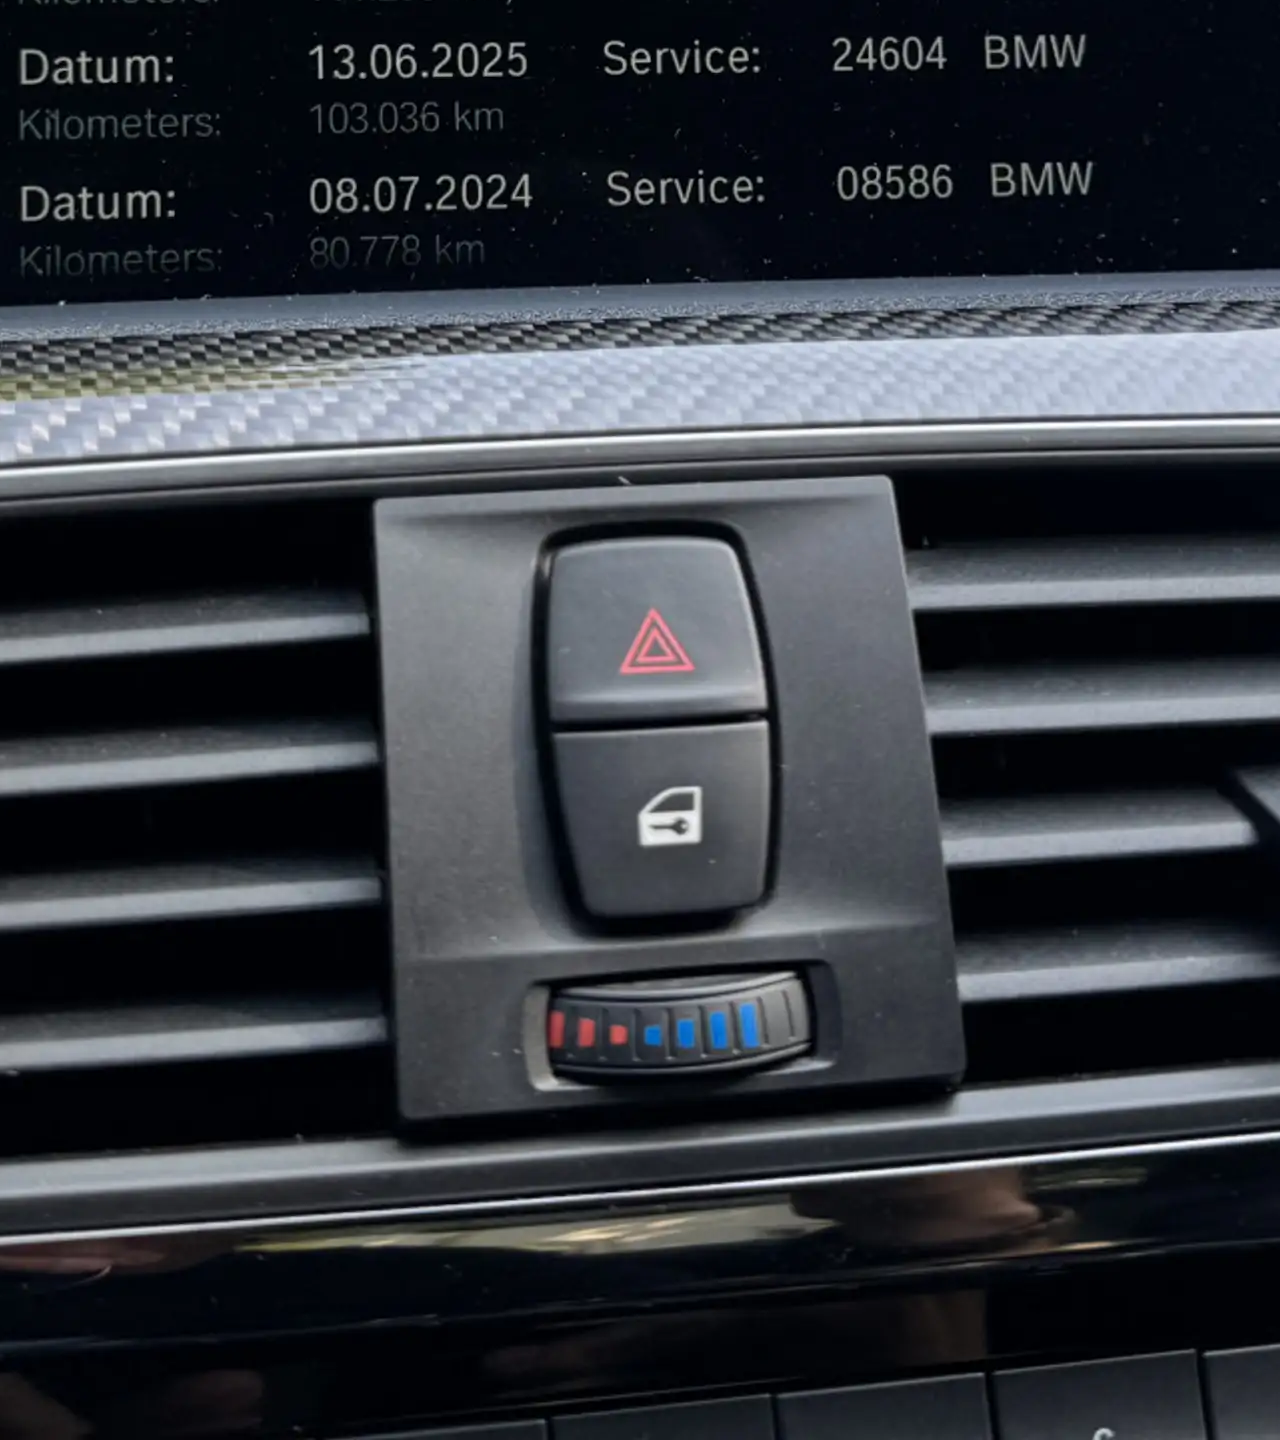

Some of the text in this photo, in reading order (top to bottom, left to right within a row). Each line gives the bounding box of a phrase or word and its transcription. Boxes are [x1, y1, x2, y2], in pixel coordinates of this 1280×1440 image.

[19, 48, 174, 86] Datum:
[308, 41, 528, 80] 13.06.2025
[603, 39, 761, 76] Service:
[832, 35, 947, 72] 24604
[984, 33, 1086, 70] BMW
[19, 100, 504, 141] Kilometers: 103.036 km
[20, 185, 176, 222] Datum:
[309, 173, 533, 214] 08.07.2024
[606, 169, 765, 207] Service:
[836, 163, 953, 201] 08586
[990, 163, 1094, 198] BMW
[19, 235, 486, 276] Kilometers: 80.778 km
